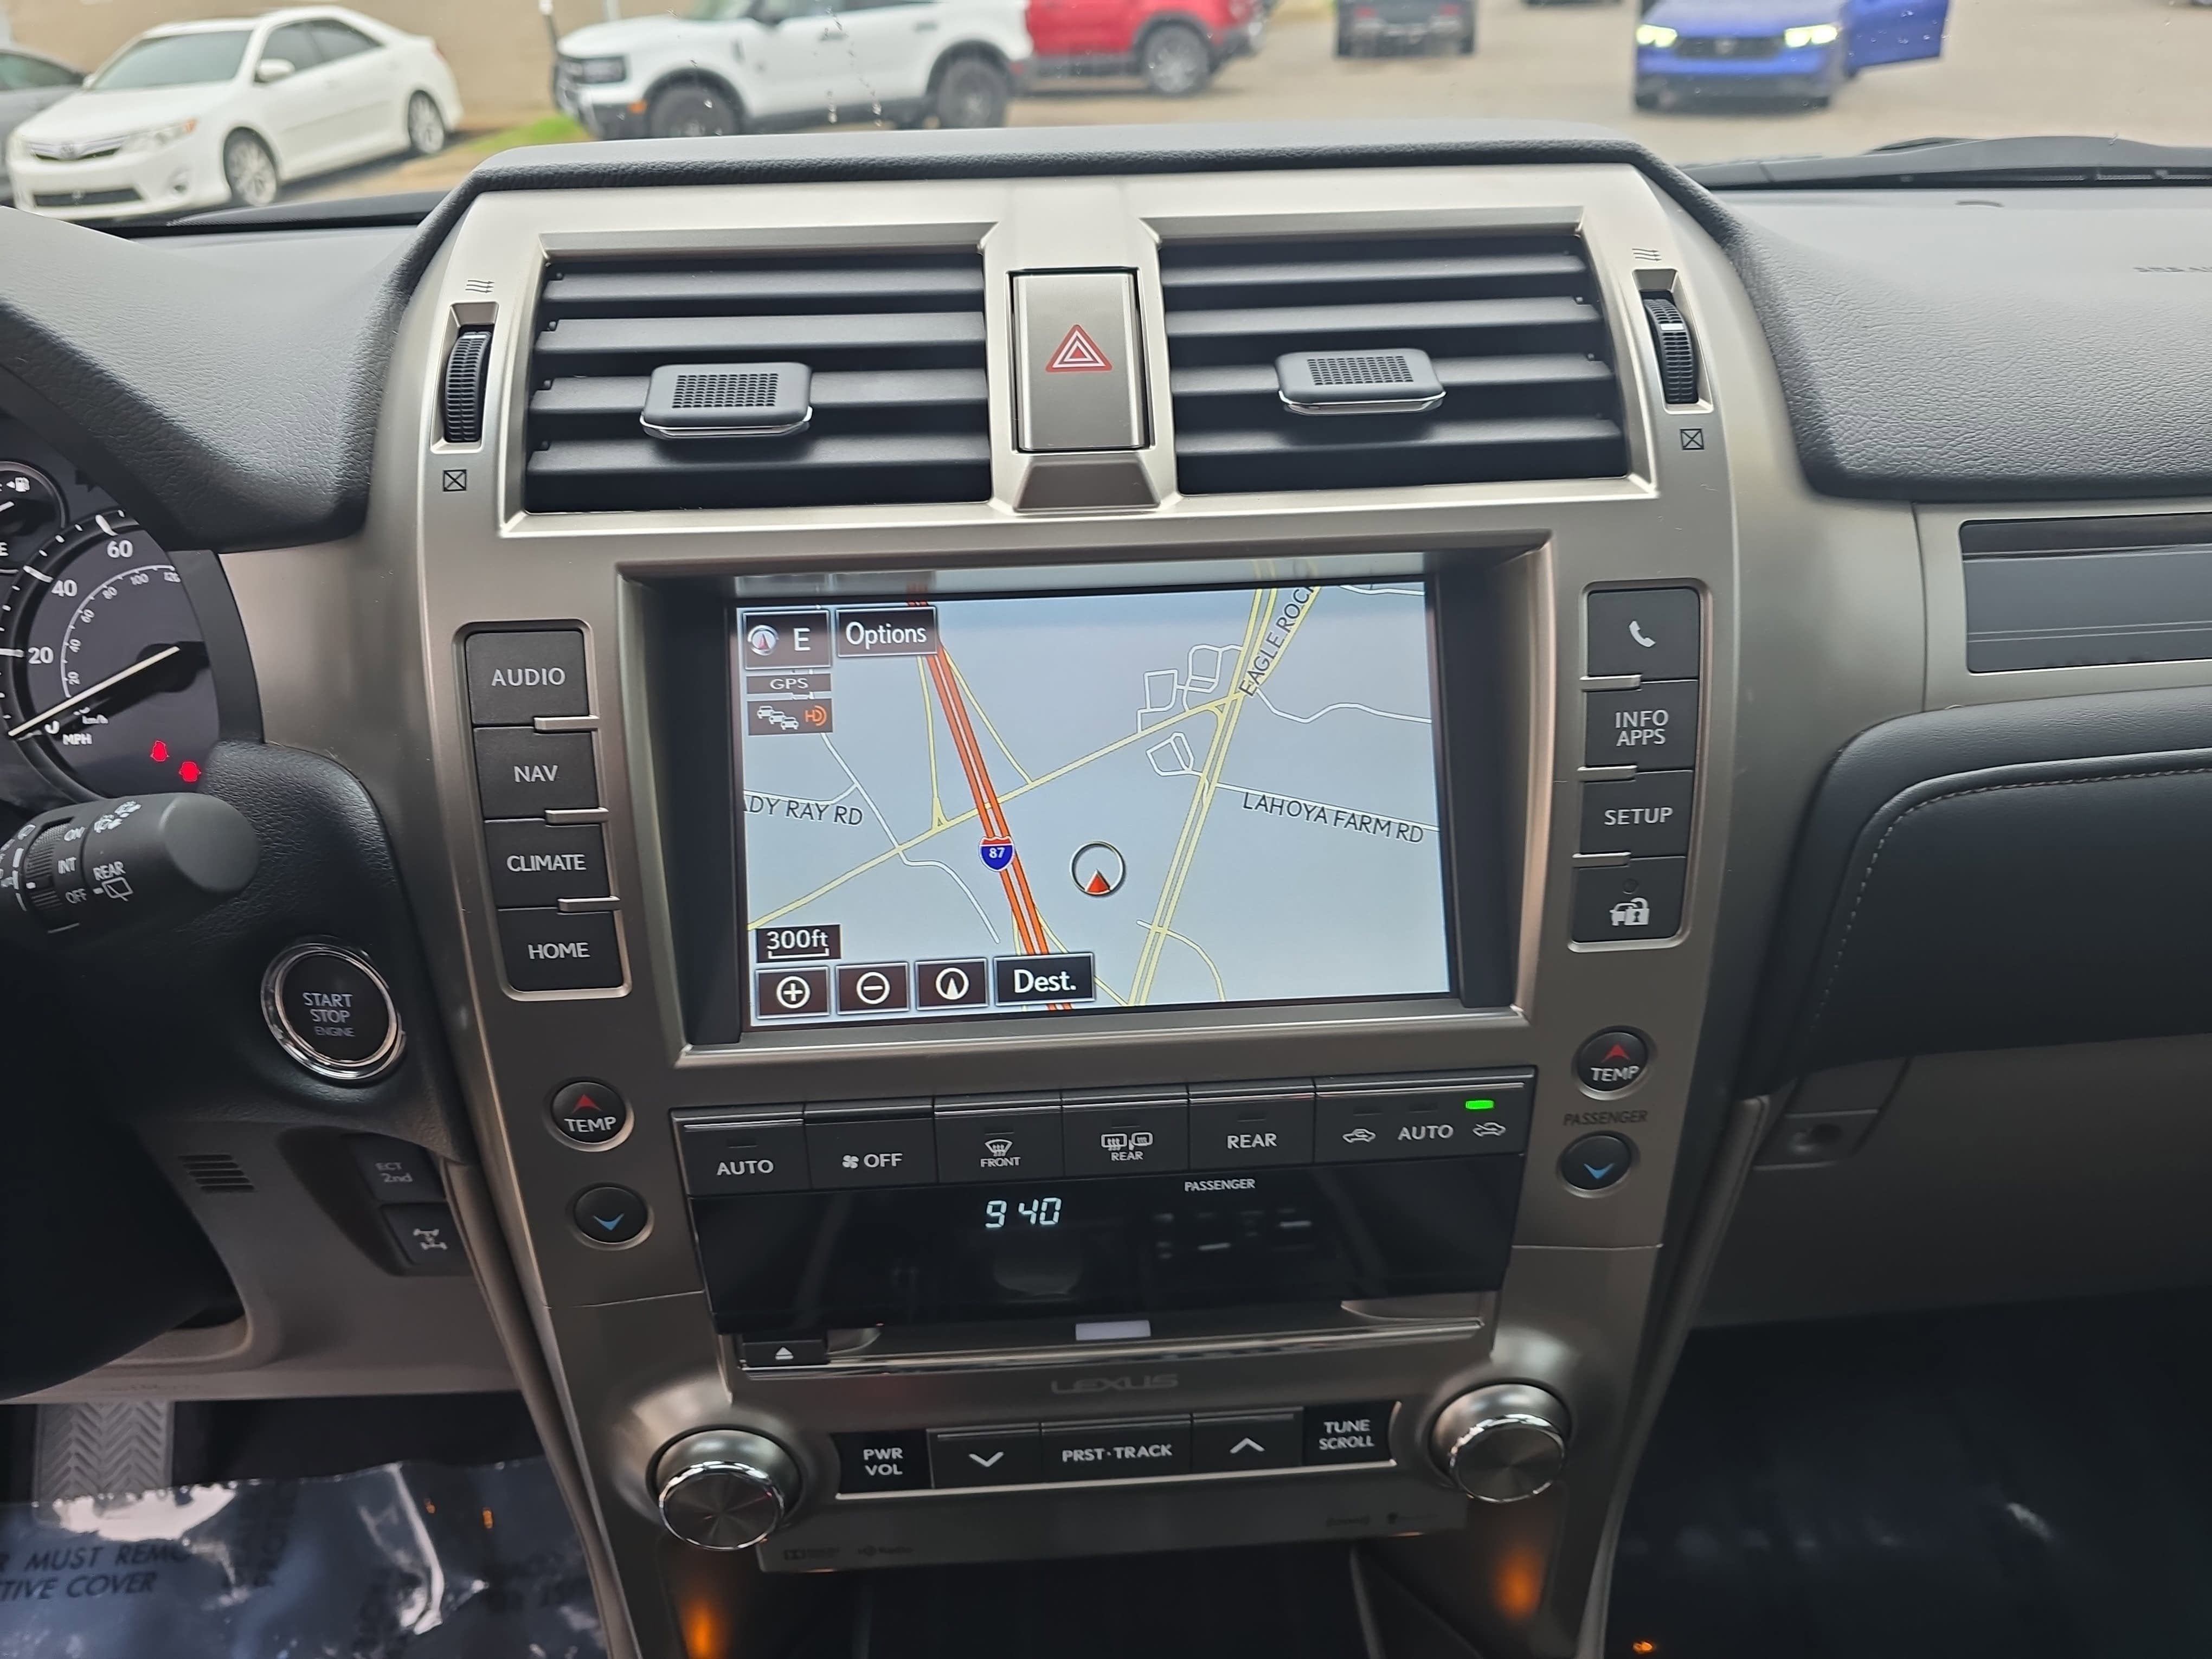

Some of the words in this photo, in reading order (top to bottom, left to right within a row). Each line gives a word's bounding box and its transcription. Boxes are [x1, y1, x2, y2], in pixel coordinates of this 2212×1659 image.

[108, 541, 132, 557] 60
[52, 580, 78, 596] 40
[81, 609, 95, 623] 60
[793, 627, 811, 651] E
[846, 621, 927, 650] Options
[69, 638, 81, 653] 40
[28, 647, 53, 664] 20
[1238, 632, 1284, 697] EAGLE
[68, 671, 80, 685] 20
[491, 667, 565, 687] AUDIO
[770, 678, 809, 690] GPS
[1615, 709, 1669, 729] INFO
[62, 733, 92, 745] MPH
[1616, 728, 1666, 747] APPS
[513, 765, 559, 782] NAV
[786, 800, 829, 821] RAY
[834, 806, 863, 826] RD
[1243, 792, 1328, 824] LAHOYA
[1333, 810, 1391, 838] FARM
[1396, 823, 1424, 843] RD
[1604, 807, 1673, 825] SETUP
[989, 847, 1005, 859] 87
[506, 854, 587, 871] CLIMATE
[93, 861, 126, 881] REAR
[65, 888, 87, 904] OFF
[766, 928, 829, 950] 300ft
[528, 942, 590, 960] HOME
[1014, 969, 1077, 993] Dest.
[303, 992, 353, 1007] START
[310, 1009, 350, 1023] STOP
[1591, 1065, 1639, 1082] TEMP
[564, 1116, 616, 1133] TEMP
[1563, 1110, 1648, 1126] PASSENGER
[1398, 1124, 1454, 1141] AUTO
[1227, 1133, 1277, 1149] REAR
[863, 1153, 903, 1168] OFF
[980, 1156, 1021, 1168] FRONT
[1111, 1150, 1143, 1161] REAR
[717, 1160, 774, 1175] AUTO
[381, 1173, 413, 1182] 2nd
[1184, 1178, 1256, 1192] PASSENGER
[1050, 1373, 1179, 1394] LEXUS
[1324, 1419, 1370, 1434] TUNE
[1319, 1434, 1375, 1450] SCROLL
[863, 1448, 904, 1461] PWR
[865, 1464, 903, 1477] VOL
[24, 1546, 105, 1572] MUST
[66, 1572, 157, 1598] COVER
